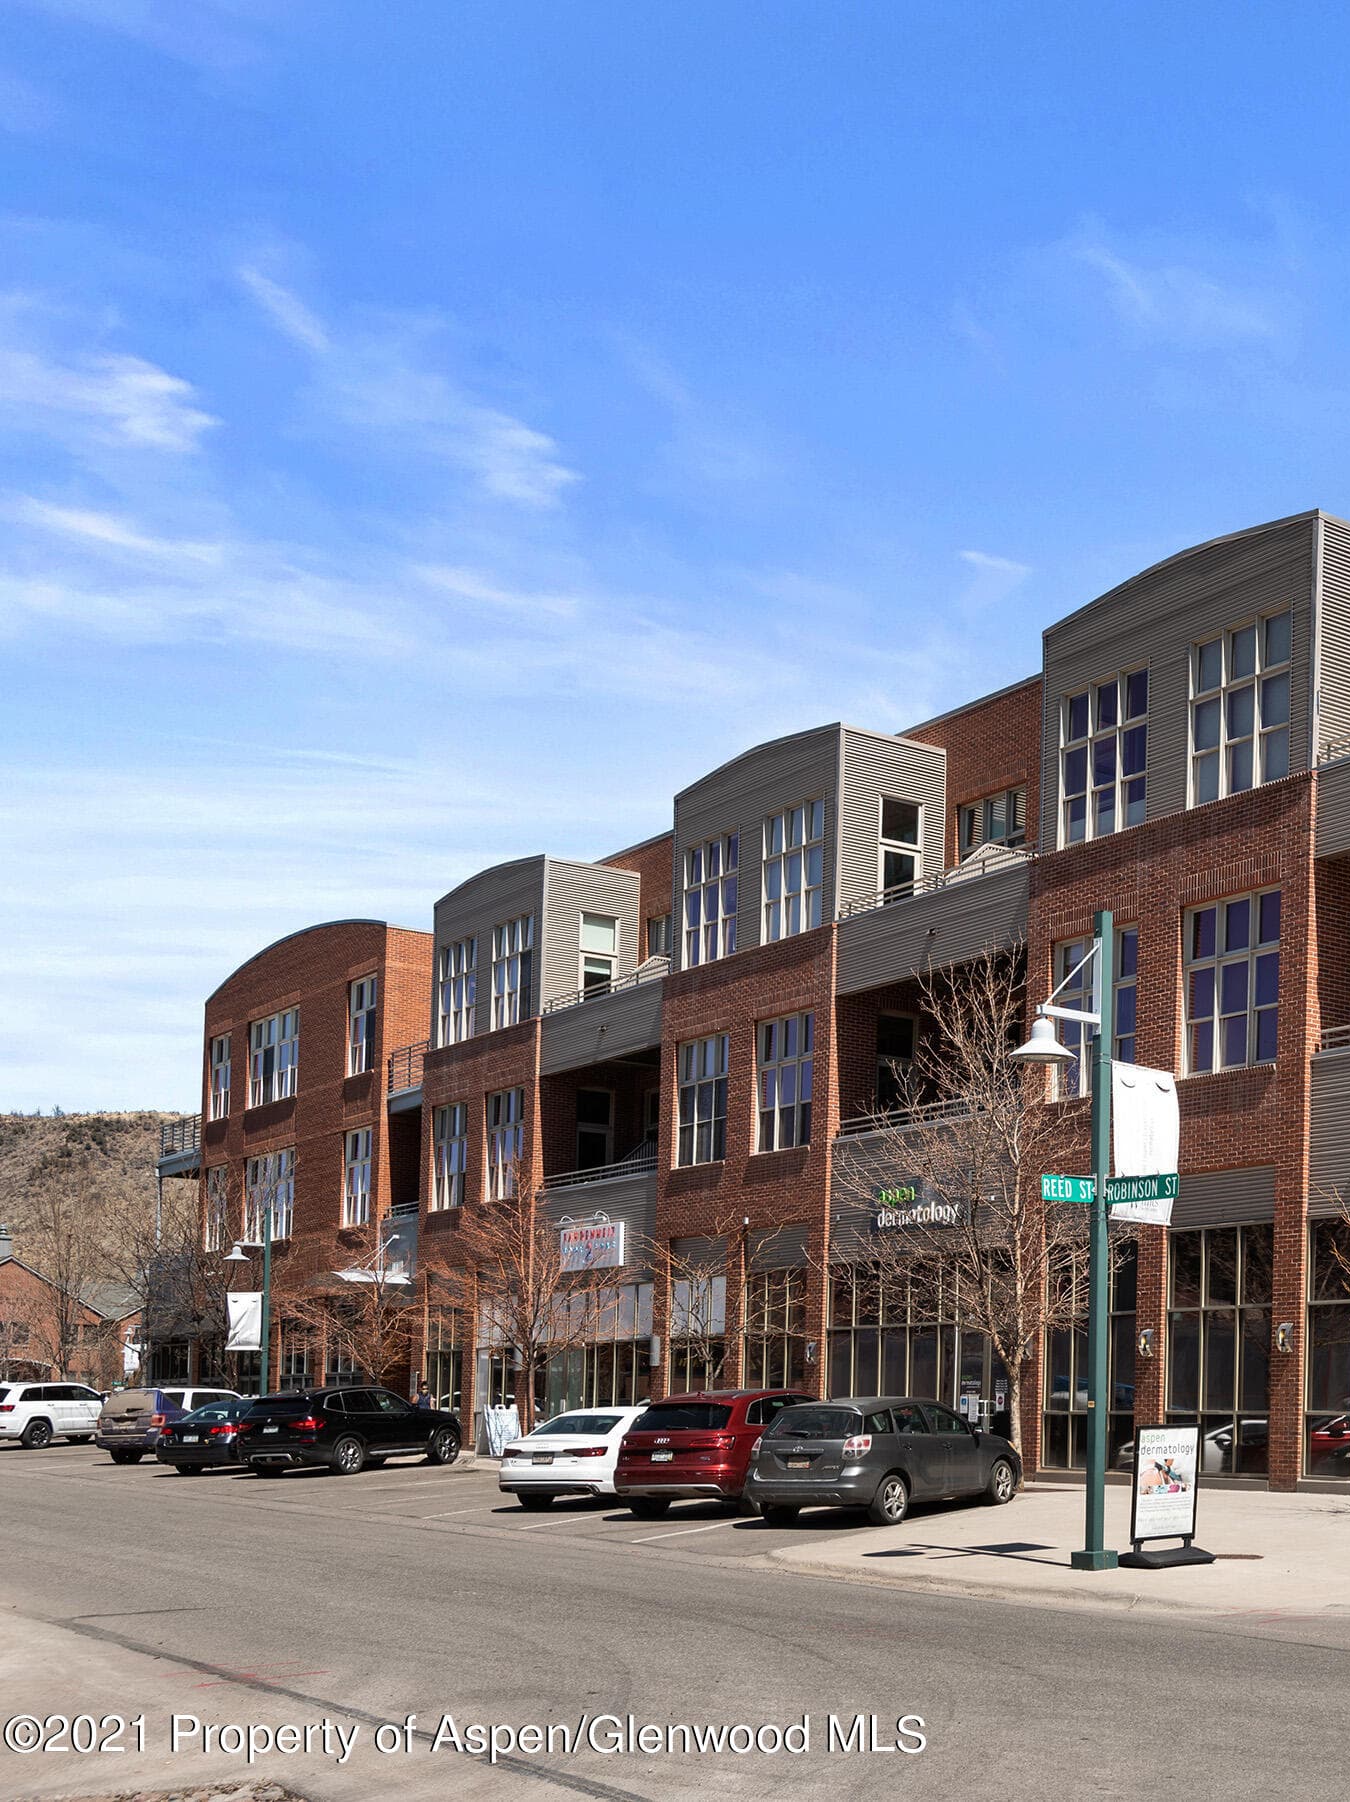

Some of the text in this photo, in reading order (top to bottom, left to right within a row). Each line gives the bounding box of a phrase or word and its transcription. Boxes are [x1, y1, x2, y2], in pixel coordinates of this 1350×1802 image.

[879, 1186, 915, 1207] aspen
[1043, 1178, 1093, 1199] REED ST
[1107, 1176, 1178, 1201] ROBINSON ST
[877, 1201, 959, 1228] dermatology
[1141, 1434, 1166, 1444] aspen
[1141, 1444, 1194, 1455] dermatology
